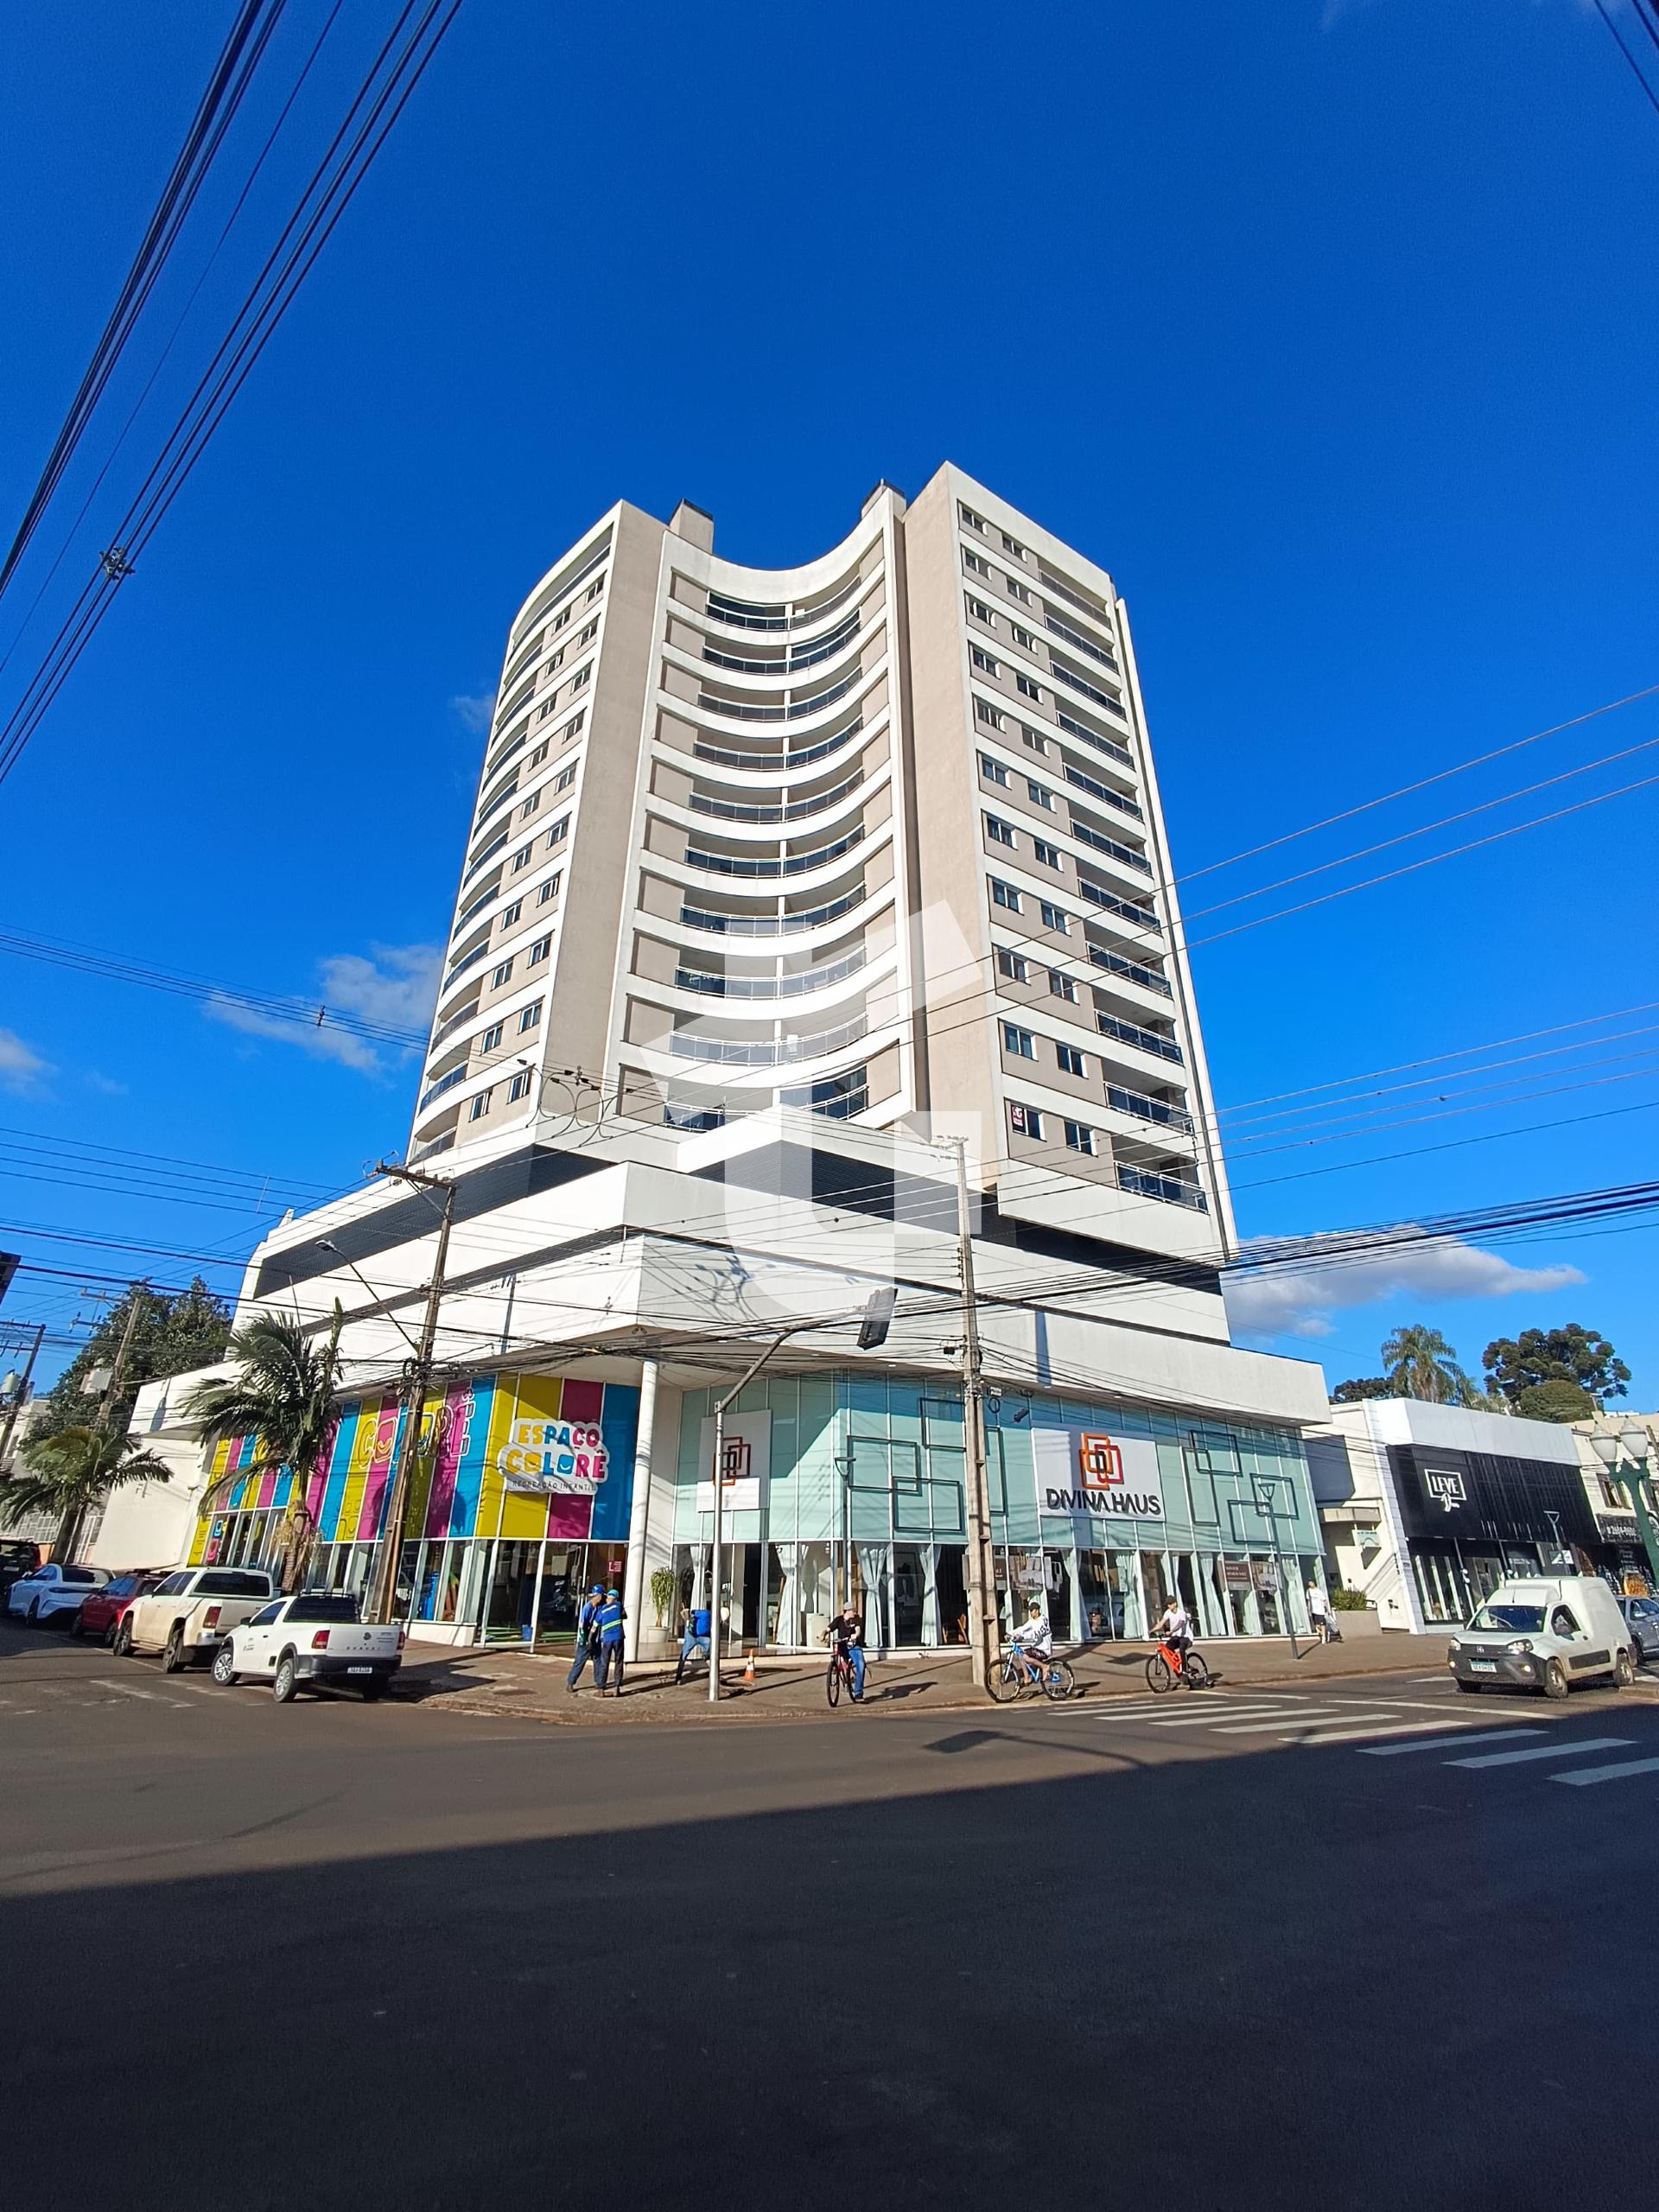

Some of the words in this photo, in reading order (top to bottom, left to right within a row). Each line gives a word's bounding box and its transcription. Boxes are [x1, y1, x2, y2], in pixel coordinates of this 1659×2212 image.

[518, 1424, 600, 1450] ESPAÇO
[506, 1449, 607, 1478] COLORÊ
[1431, 1476, 1459, 1494] LEVE
[1046, 1488, 1110, 1513] DIVINA
[1111, 1492, 1161, 1515] HAUS
